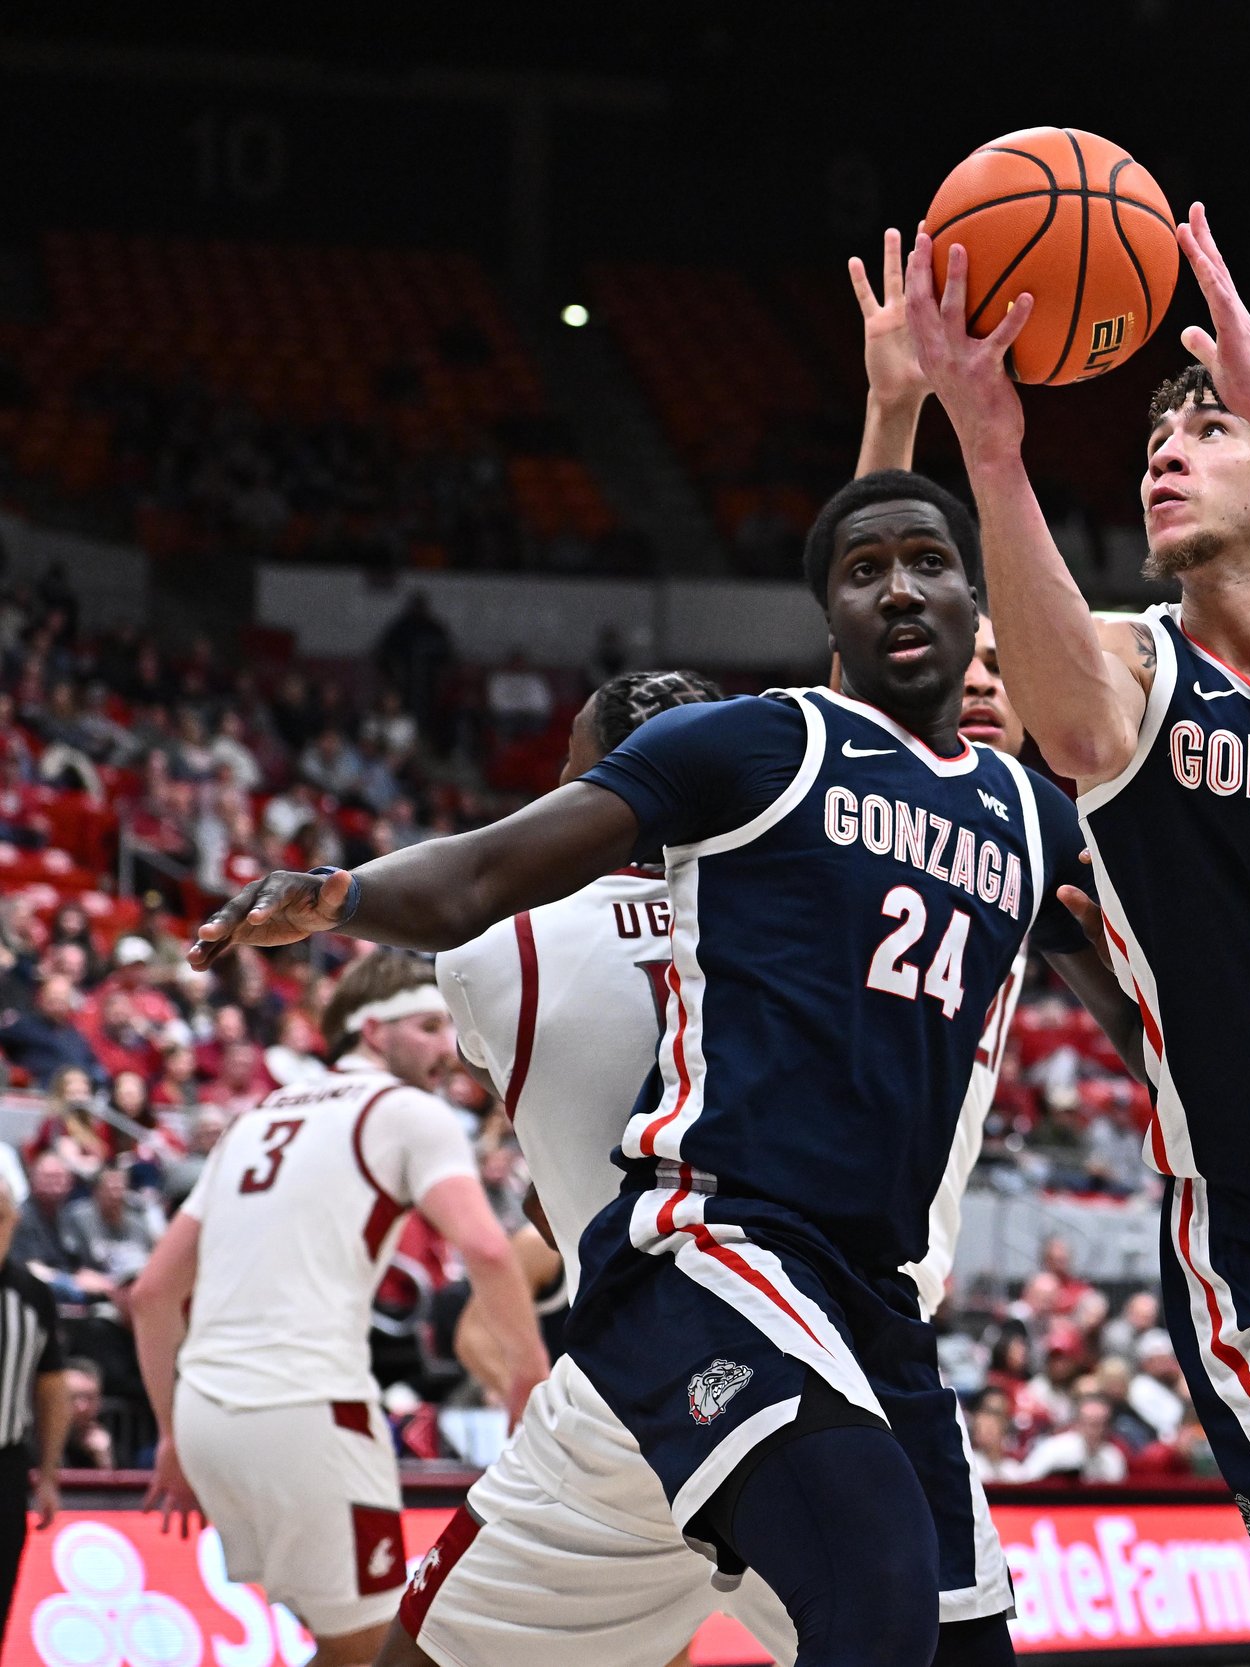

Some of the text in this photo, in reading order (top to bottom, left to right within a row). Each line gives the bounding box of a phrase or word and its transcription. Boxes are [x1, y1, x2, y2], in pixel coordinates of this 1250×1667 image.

[976, 788, 1010, 823] WCC
[823, 785, 1022, 921] GONZAGA
[612, 901, 671, 939] UG
[865, 884, 973, 1021] 24
[238, 1118, 305, 1195] 3
